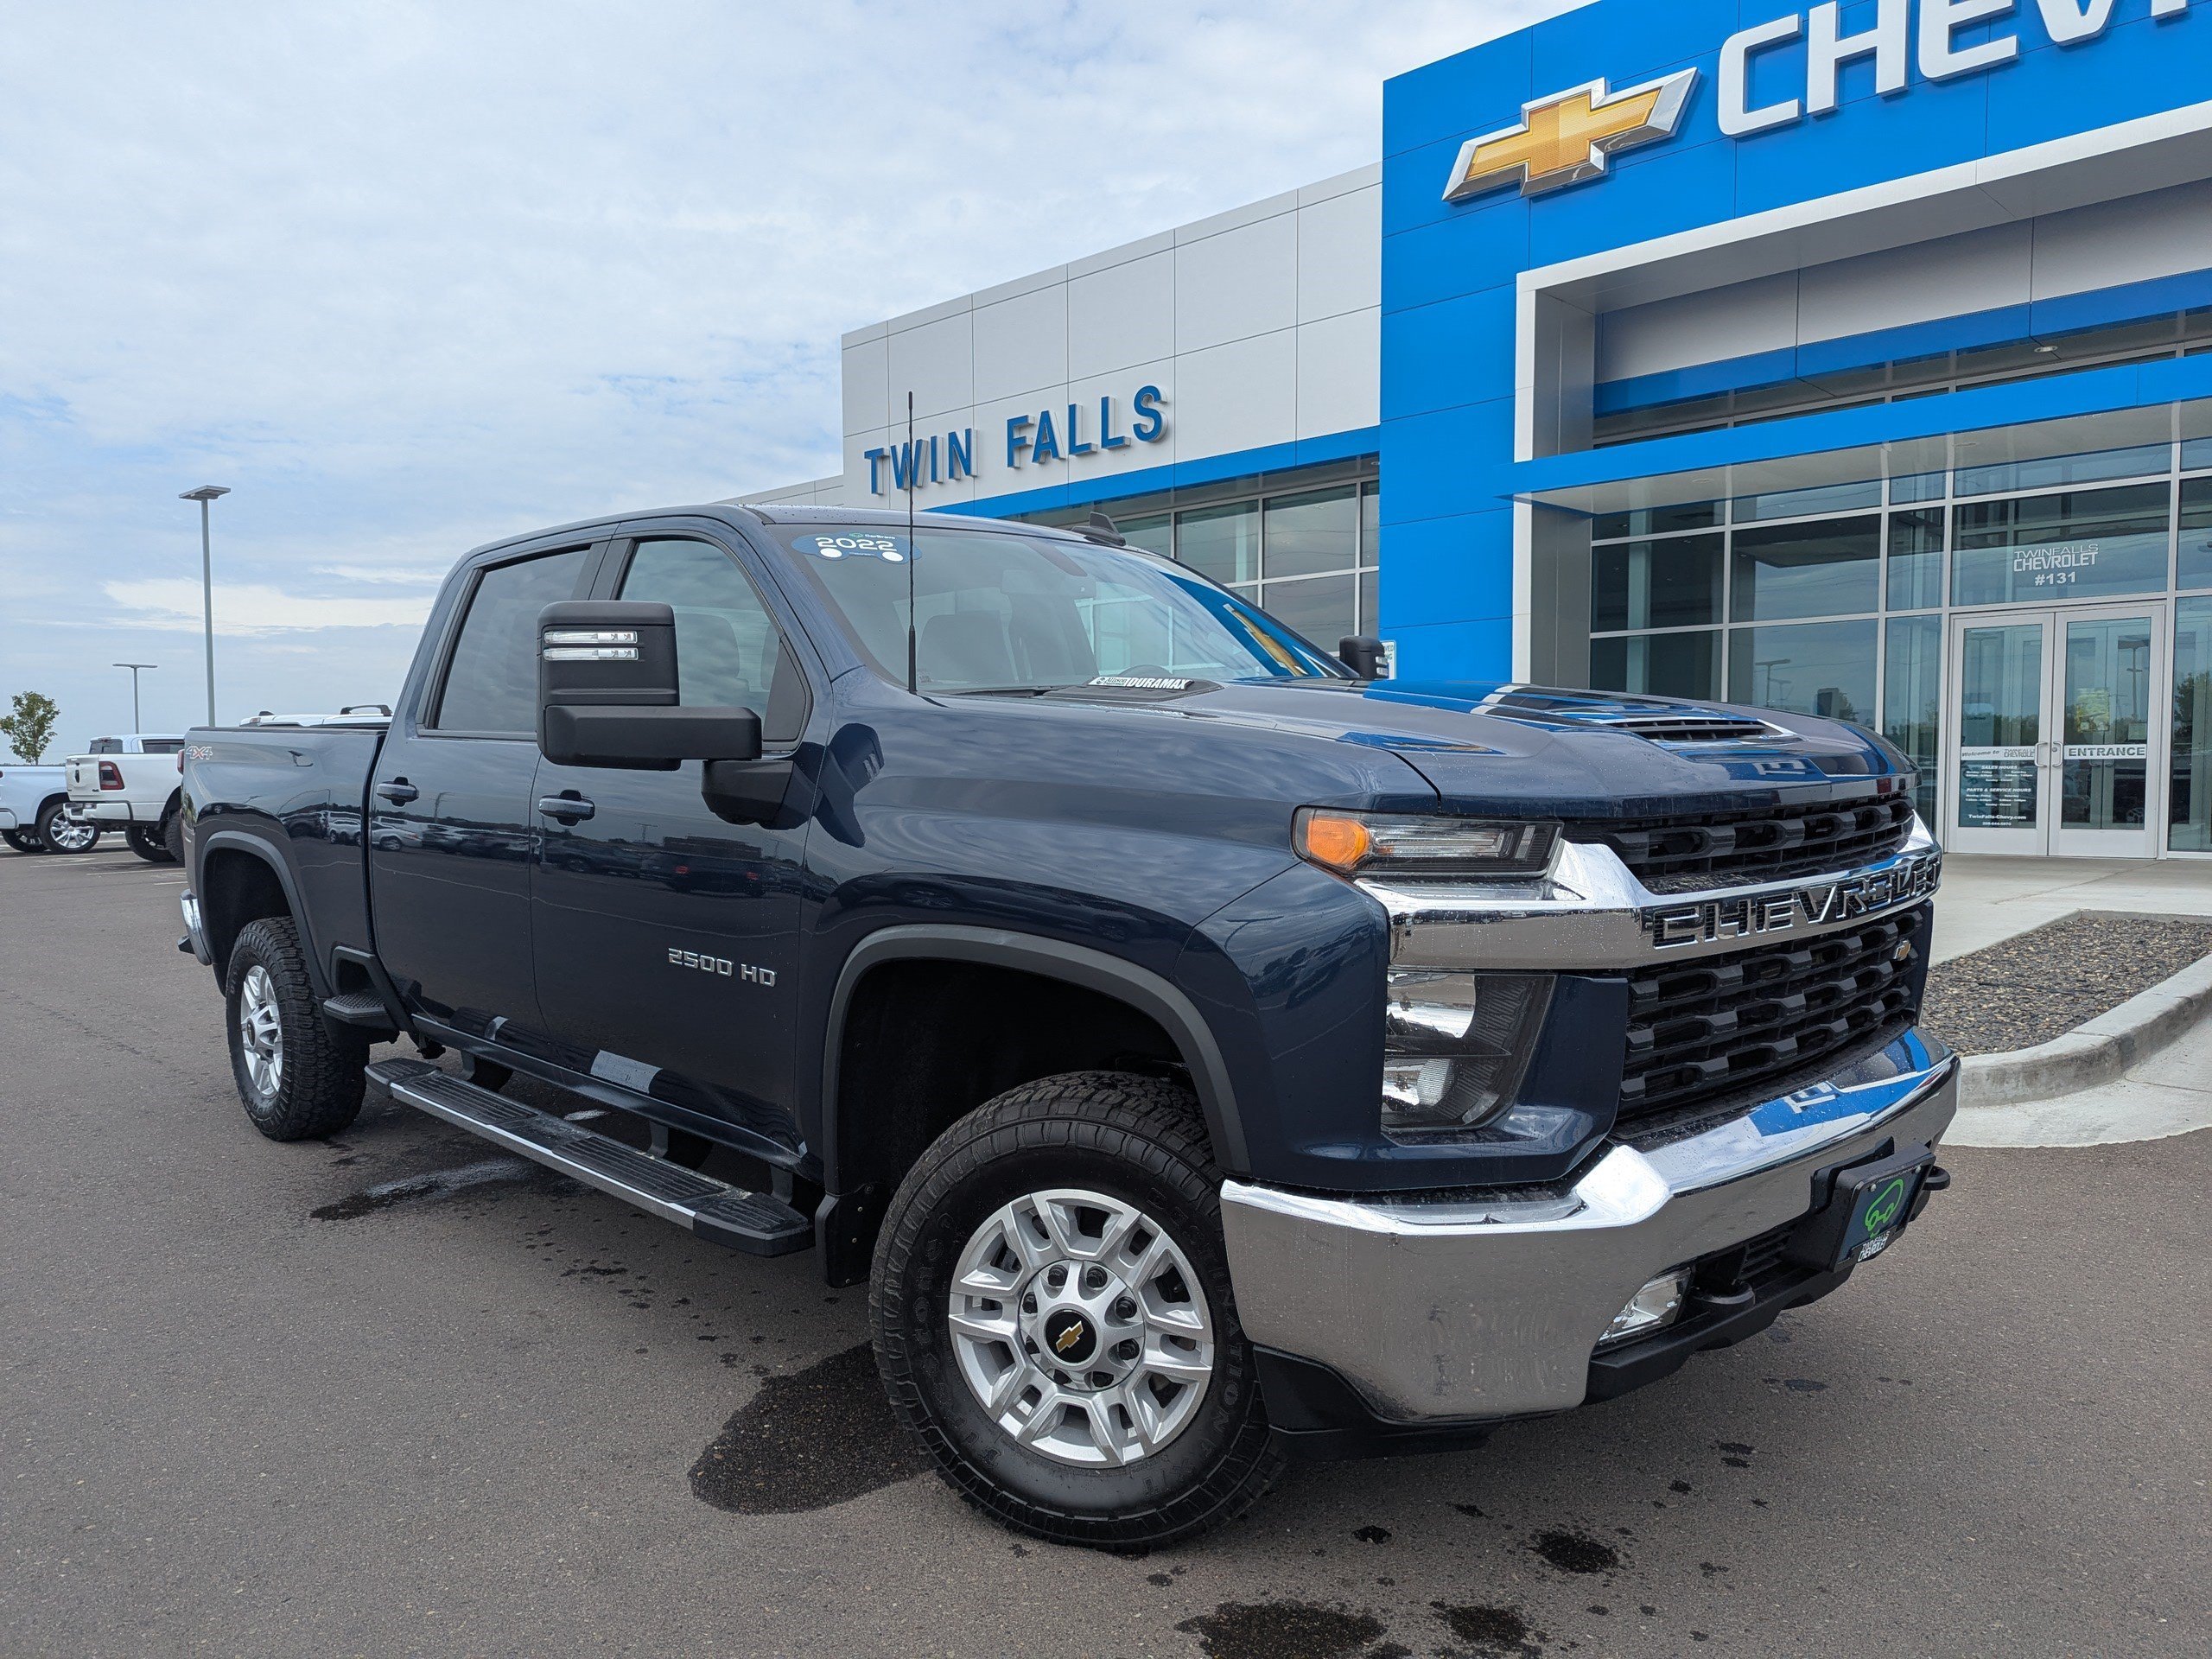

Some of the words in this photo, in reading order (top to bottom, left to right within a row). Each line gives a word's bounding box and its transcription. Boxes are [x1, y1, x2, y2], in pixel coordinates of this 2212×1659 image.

[864, 428, 978, 495] TWIN
[1007, 385, 1168, 469] FALLS
[815, 537, 898, 552] 2022
[2014, 543, 2099, 559] TWINFALLS
[2013, 551, 2099, 572] CHEVROLET
[2034, 571, 2076, 587] #131
[1127, 677, 1192, 690] DURAMAX
[2068, 747, 2145, 757] ENTRANCE
[1653, 861, 1942, 950] CHEVROLET
[668, 947, 734, 977] 2500
[741, 963, 778, 988] HD
